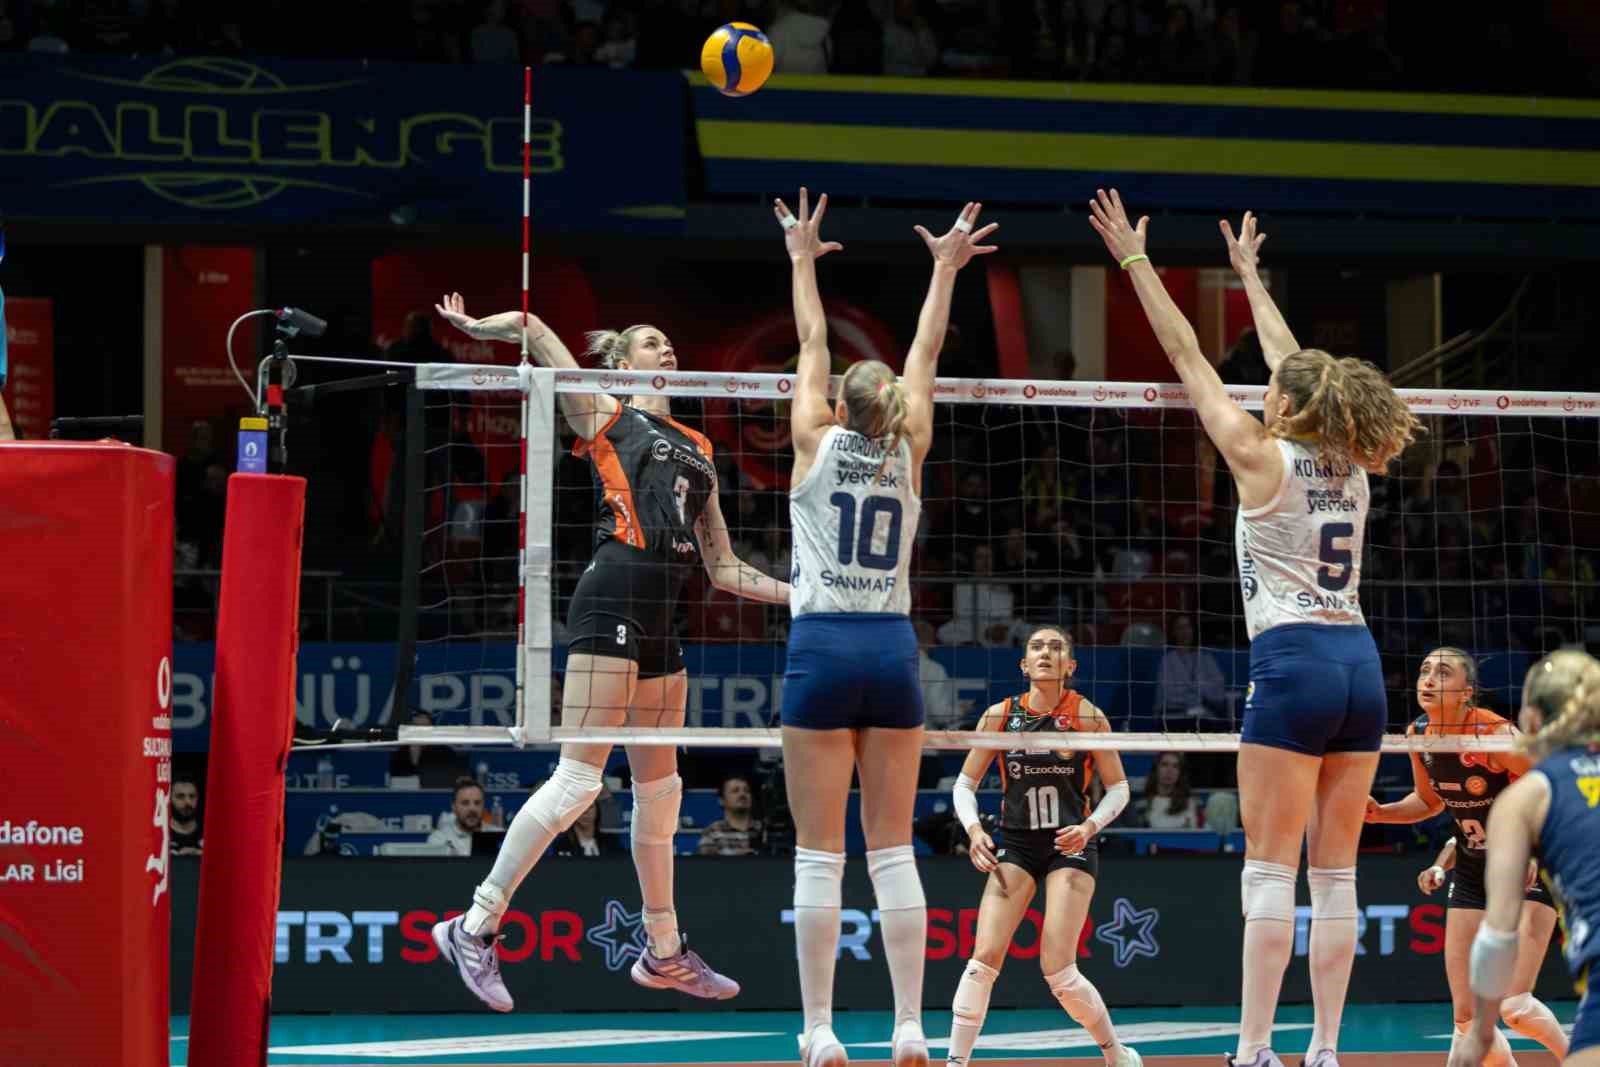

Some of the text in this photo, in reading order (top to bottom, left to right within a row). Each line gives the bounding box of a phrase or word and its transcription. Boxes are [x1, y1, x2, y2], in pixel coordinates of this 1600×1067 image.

[1037, 386, 1078, 397] vodafone
[1108, 391, 1128, 400] TVF
[1461, 399, 1481, 408] TVF
[1511, 398, 1549, 408] vodafone
[1307, 496, 1359, 515] yemek
[830, 491, 903, 571] 10
[1317, 522, 1354, 591] 5
[616, 624, 627, 645] 3
[1024, 786, 1060, 831] 10
[273, 910, 398, 964] TRT
